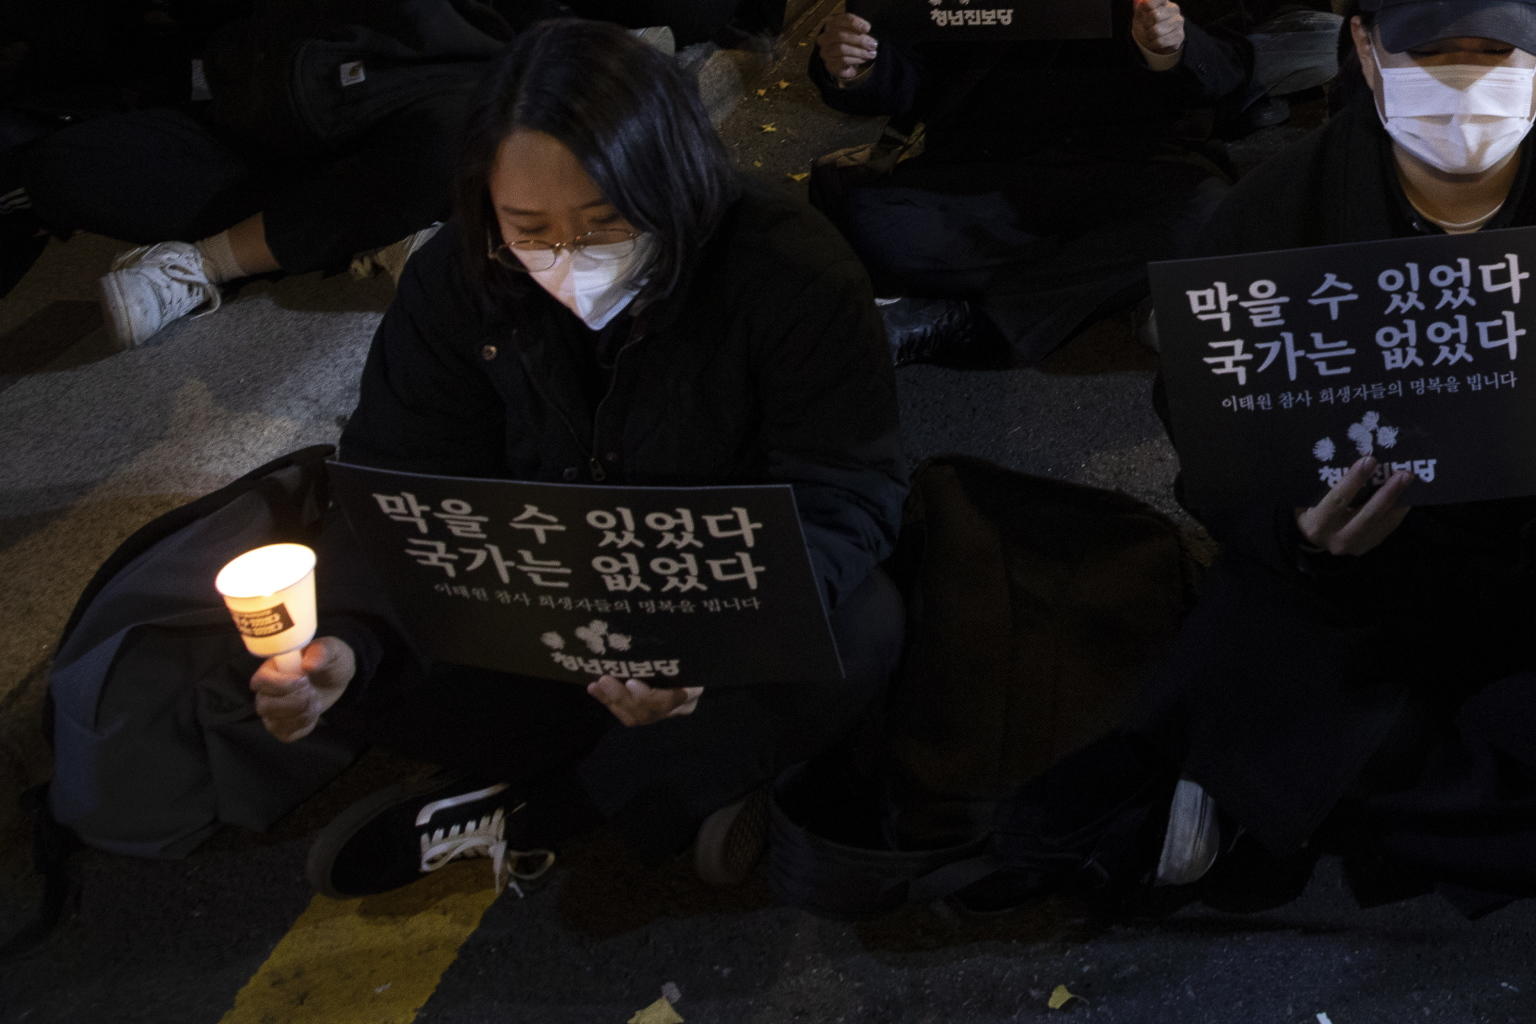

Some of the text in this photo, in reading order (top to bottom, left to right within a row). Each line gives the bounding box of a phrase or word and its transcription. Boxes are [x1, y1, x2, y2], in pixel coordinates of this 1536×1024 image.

[1185, 253, 1530, 333] 막을 수 있었다
[1202, 310, 1526, 386] 국가는 없었다
[1221, 370, 1518, 413] 이태원 참사 희생자들의 명복을 빕니다
[372, 491, 763, 550] 막을 수 있었다
[404, 538, 766, 592] 국가는 없었다
